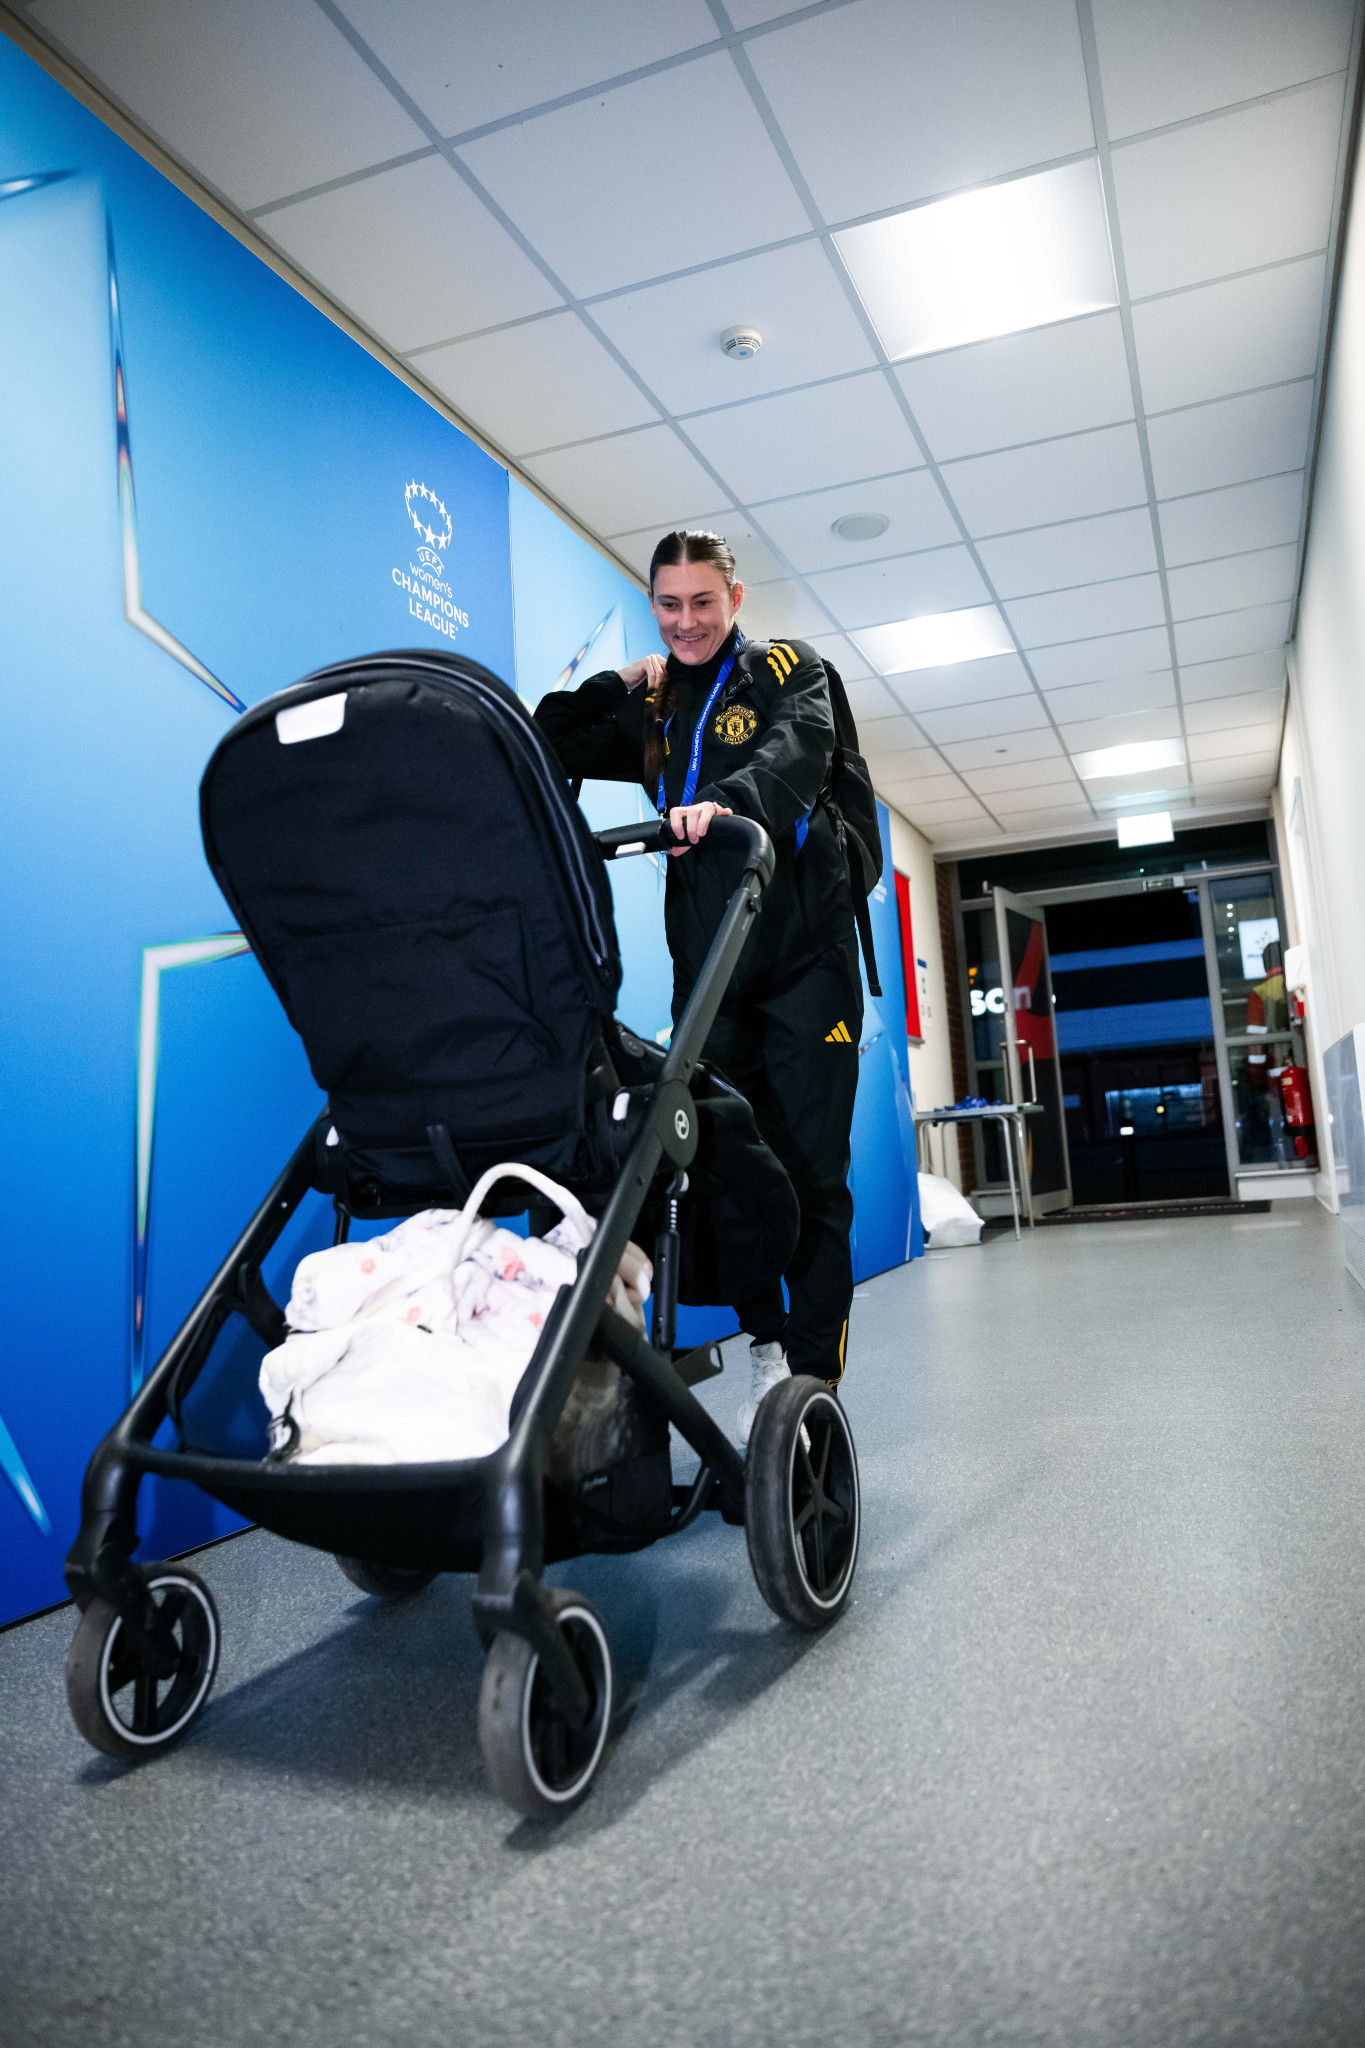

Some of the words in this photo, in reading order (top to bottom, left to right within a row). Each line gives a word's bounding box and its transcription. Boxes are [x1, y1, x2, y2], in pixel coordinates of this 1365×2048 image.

[409, 561, 453, 599] women's
[418, 550, 443, 575] UEFA
[391, 568, 470, 628] CHAMPIONS
[408, 597, 458, 641] LEAGUE
[724, 733, 749, 742] UNITED
